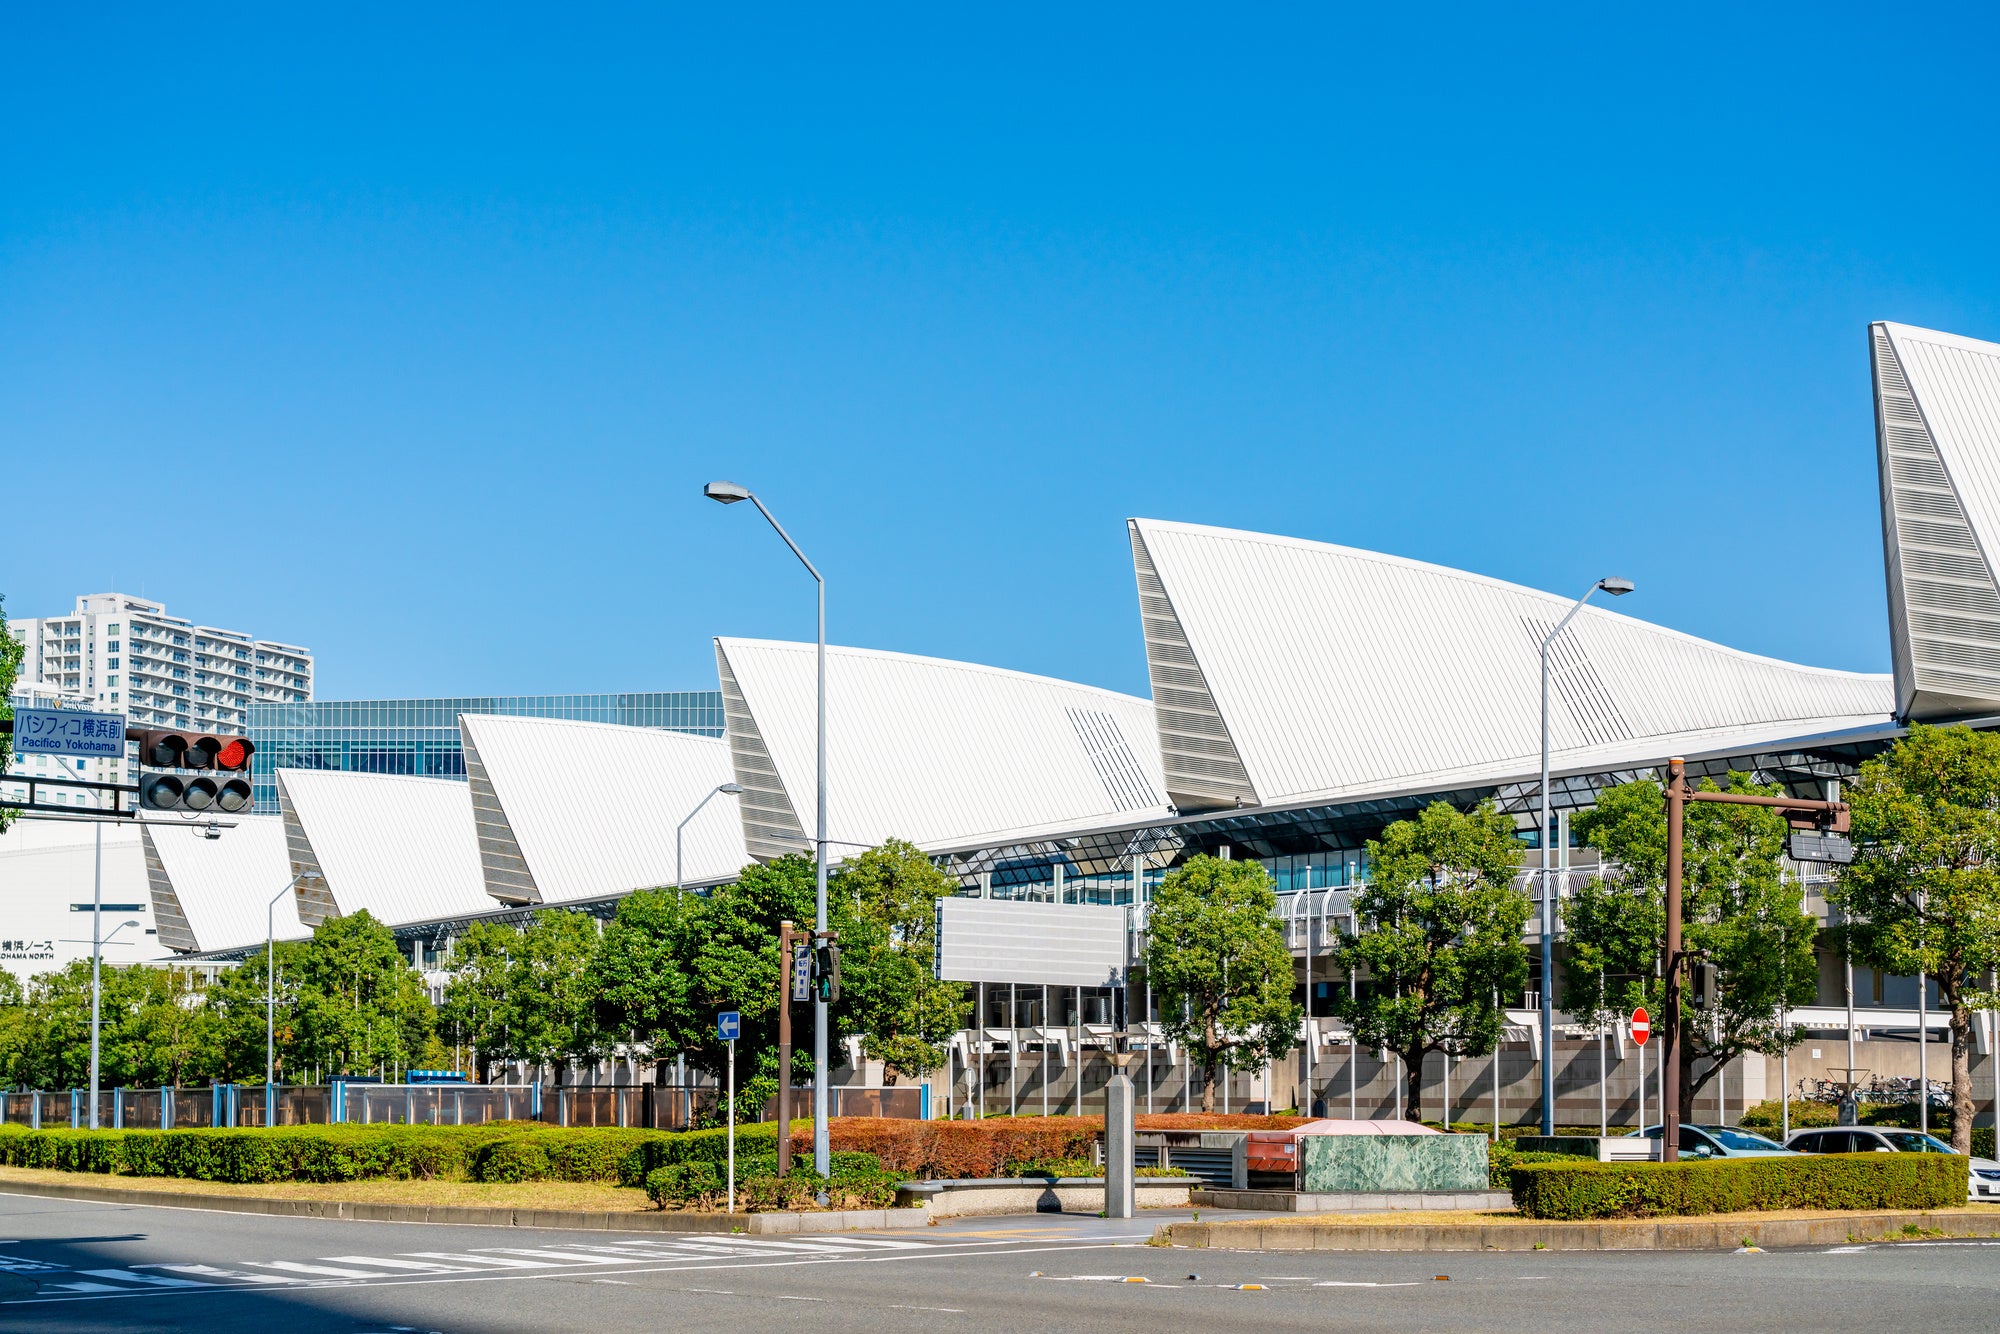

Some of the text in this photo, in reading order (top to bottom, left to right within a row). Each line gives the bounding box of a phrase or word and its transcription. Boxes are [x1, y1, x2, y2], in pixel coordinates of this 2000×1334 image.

[19, 715, 121, 739] パシフィコ横浜前
[22, 736, 116, 752] Pacifico Yokohama
